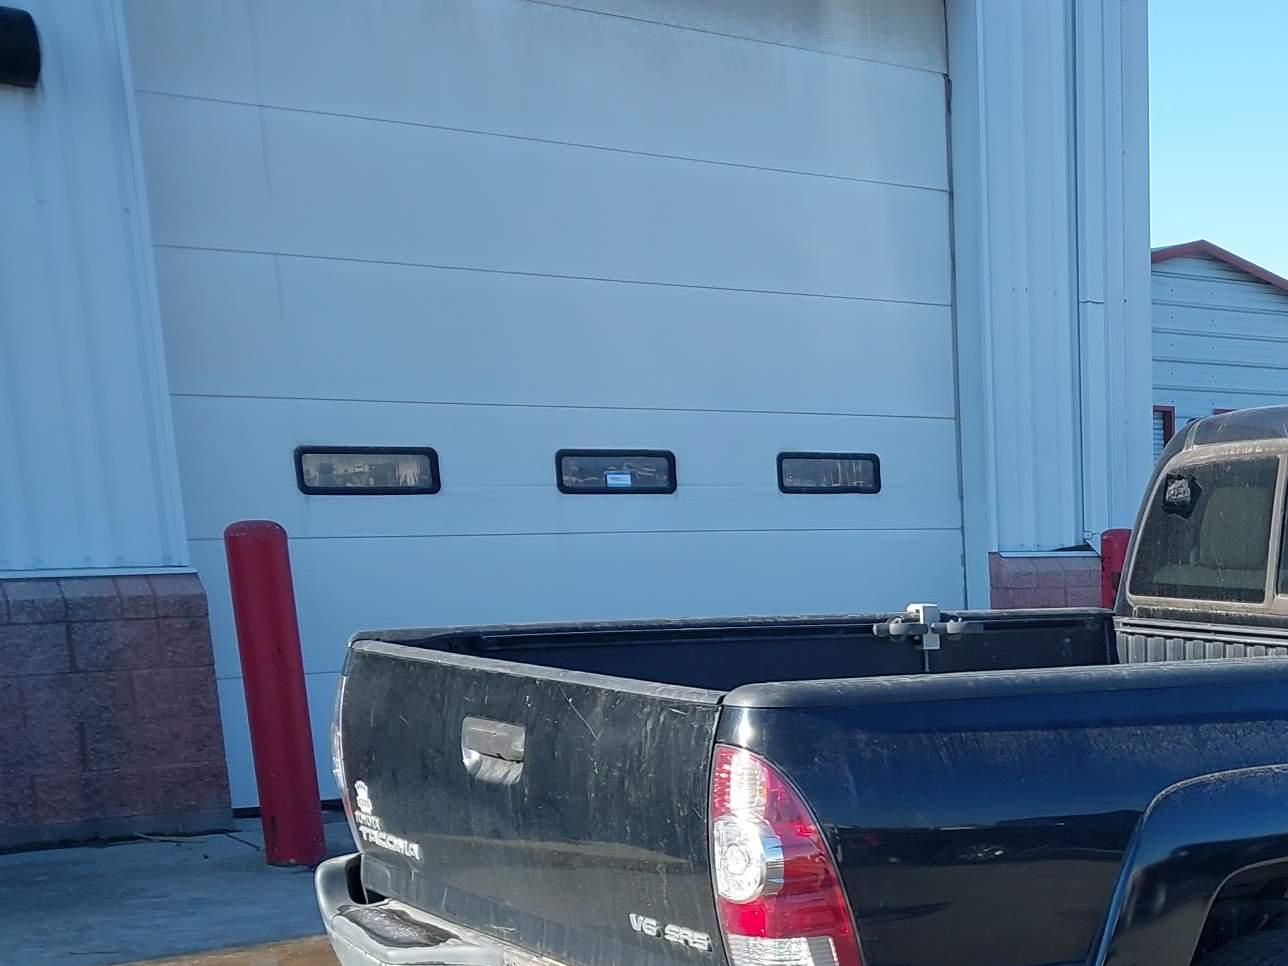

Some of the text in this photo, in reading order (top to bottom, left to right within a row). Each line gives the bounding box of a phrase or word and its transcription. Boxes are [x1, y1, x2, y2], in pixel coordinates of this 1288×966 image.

[353, 809, 381, 831] TOYOTA
[358, 826, 421, 860] TACOMA
[629, 912, 712, 952] V6 SR5
